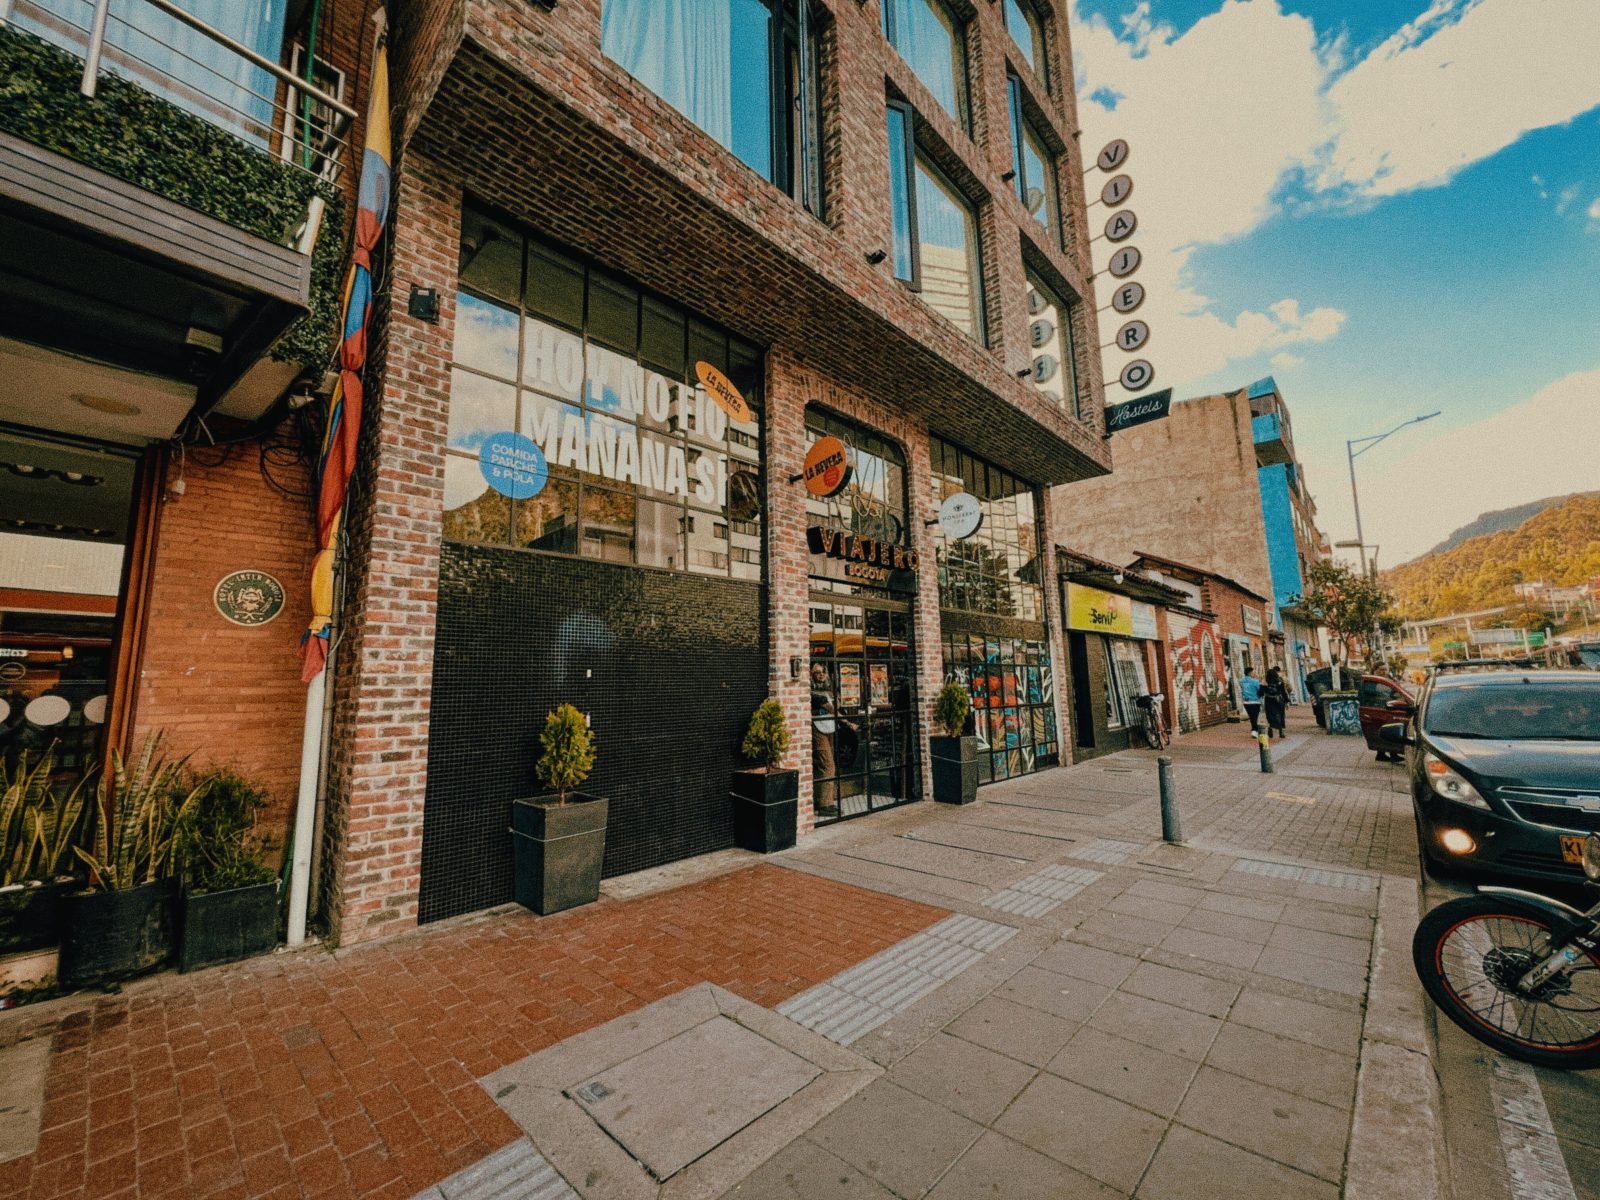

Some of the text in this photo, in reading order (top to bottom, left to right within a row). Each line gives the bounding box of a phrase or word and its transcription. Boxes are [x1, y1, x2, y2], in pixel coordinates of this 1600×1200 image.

[1104, 144, 1146, 383] VIAJERO
[522, 320, 610, 401] HOY
[620, 356, 671, 423] NO
[1110, 400, 1163, 426] Hostels
[491, 454, 537, 473] PARCHE
[492, 443, 537, 463] COMIDA
[503, 470, 534, 484] POLA
[805, 466, 815, 480] LA
[817, 526, 920, 572] VIAJERO
